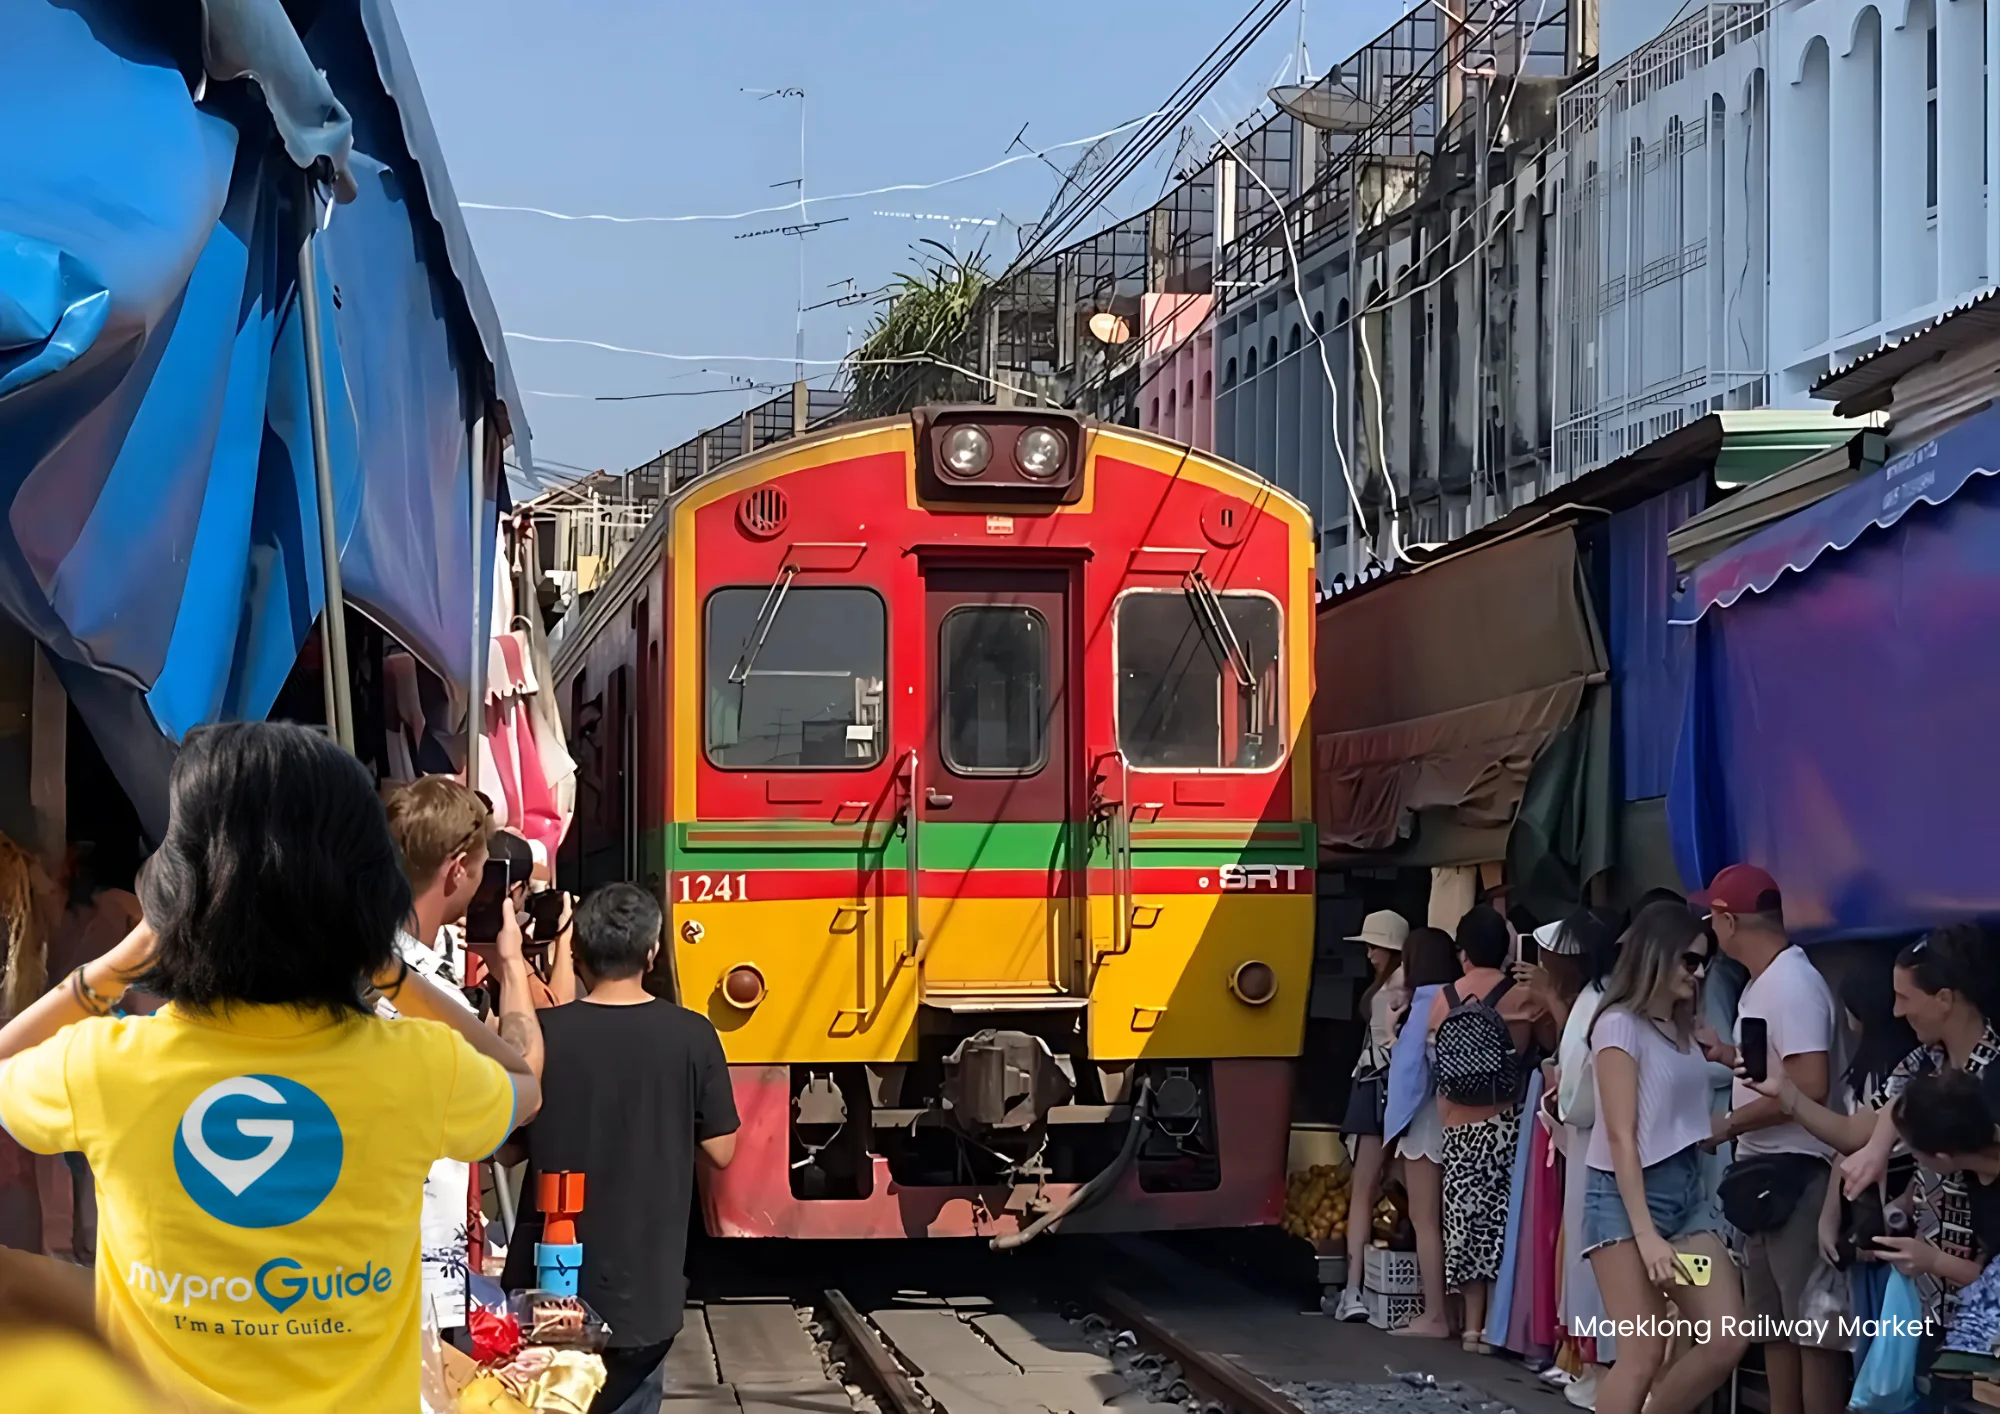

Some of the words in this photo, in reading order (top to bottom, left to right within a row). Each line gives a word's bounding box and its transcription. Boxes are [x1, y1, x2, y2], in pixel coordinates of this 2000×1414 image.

[679, 874, 748, 903] 1241
[1219, 863, 1305, 890] SRT
[128, 1257, 392, 1314] myproGuide
[174, 1315, 208, 1332] I'm
[214, 1323, 225, 1335] a
[231, 1319, 280, 1335] Tour
[286, 1318, 352, 1335] Guide.
